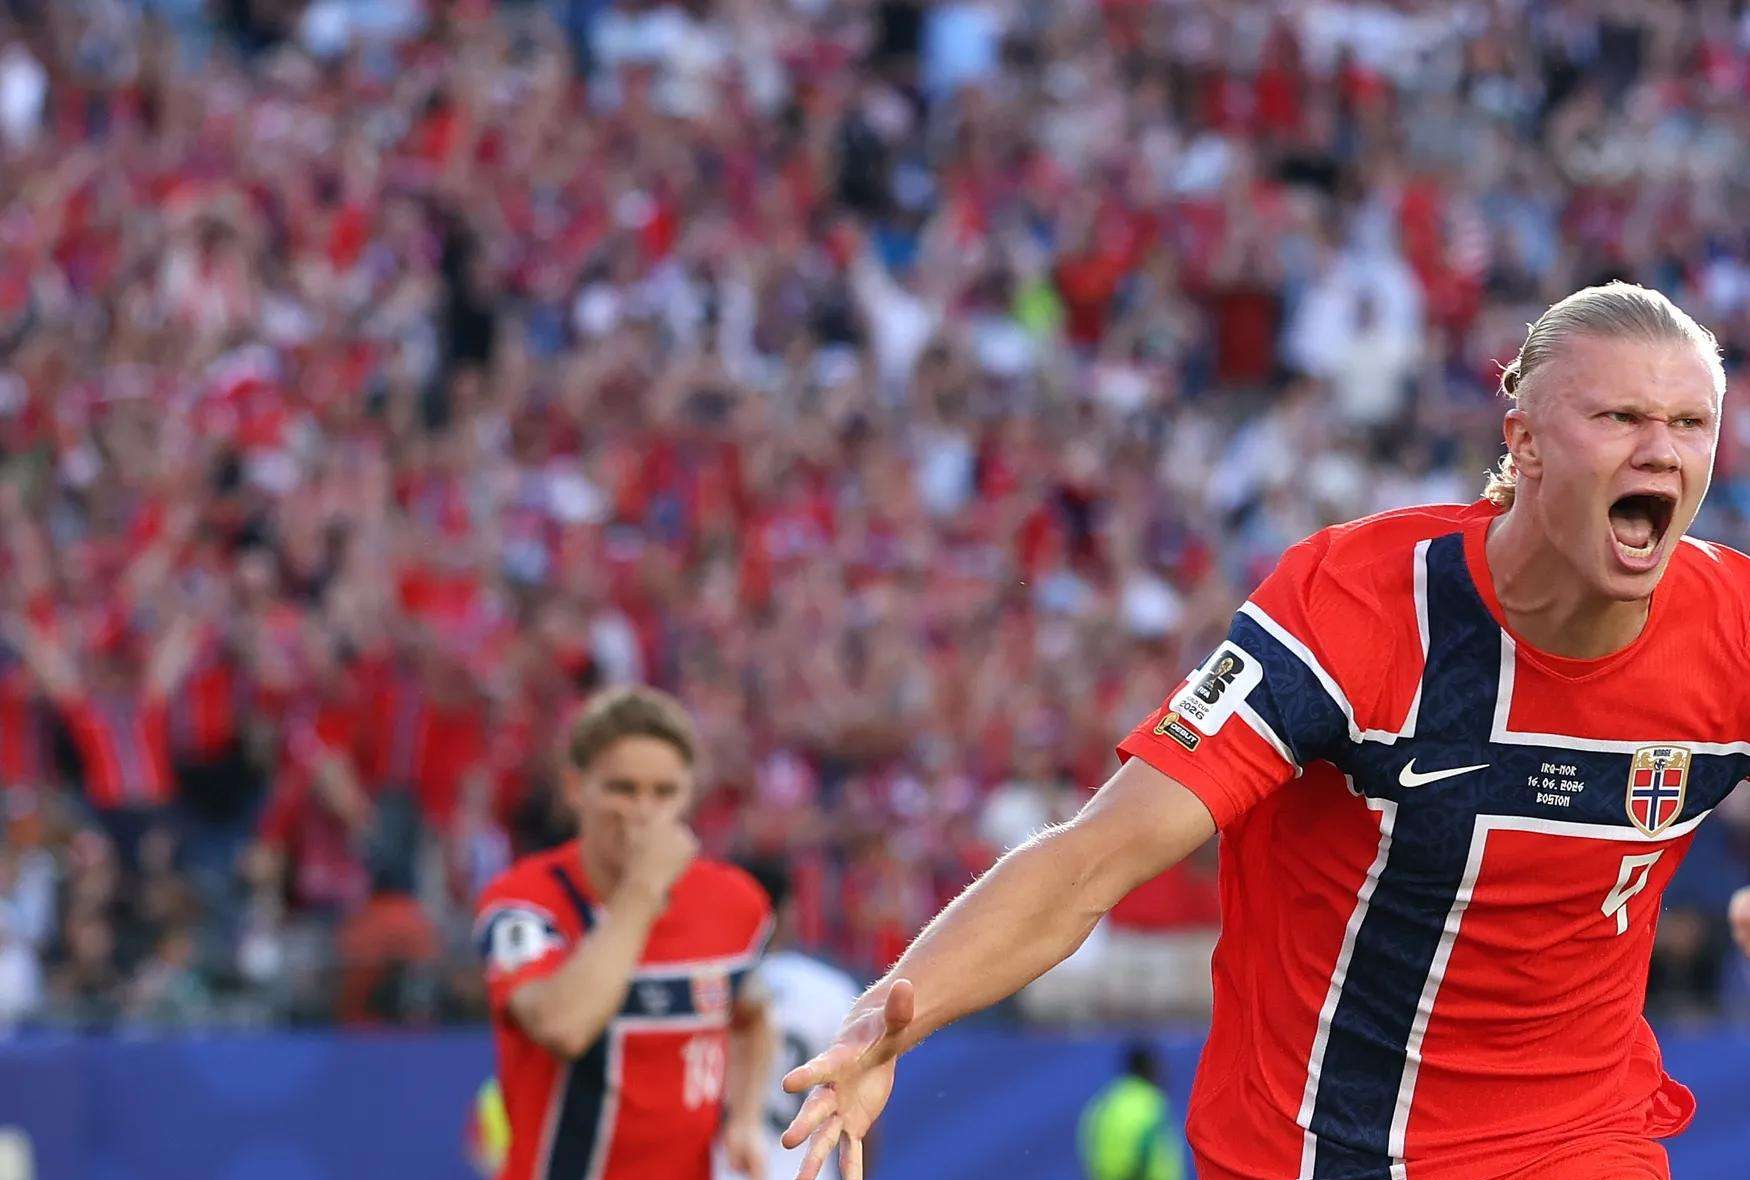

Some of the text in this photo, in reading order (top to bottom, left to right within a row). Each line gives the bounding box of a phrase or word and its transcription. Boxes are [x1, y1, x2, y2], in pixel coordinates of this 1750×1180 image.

[1180, 700, 1205, 720] 2026
[1170, 723, 1198, 742] DEBUT
[1536, 792, 1570, 807] BOSTON
[1601, 849, 1664, 935] 9
